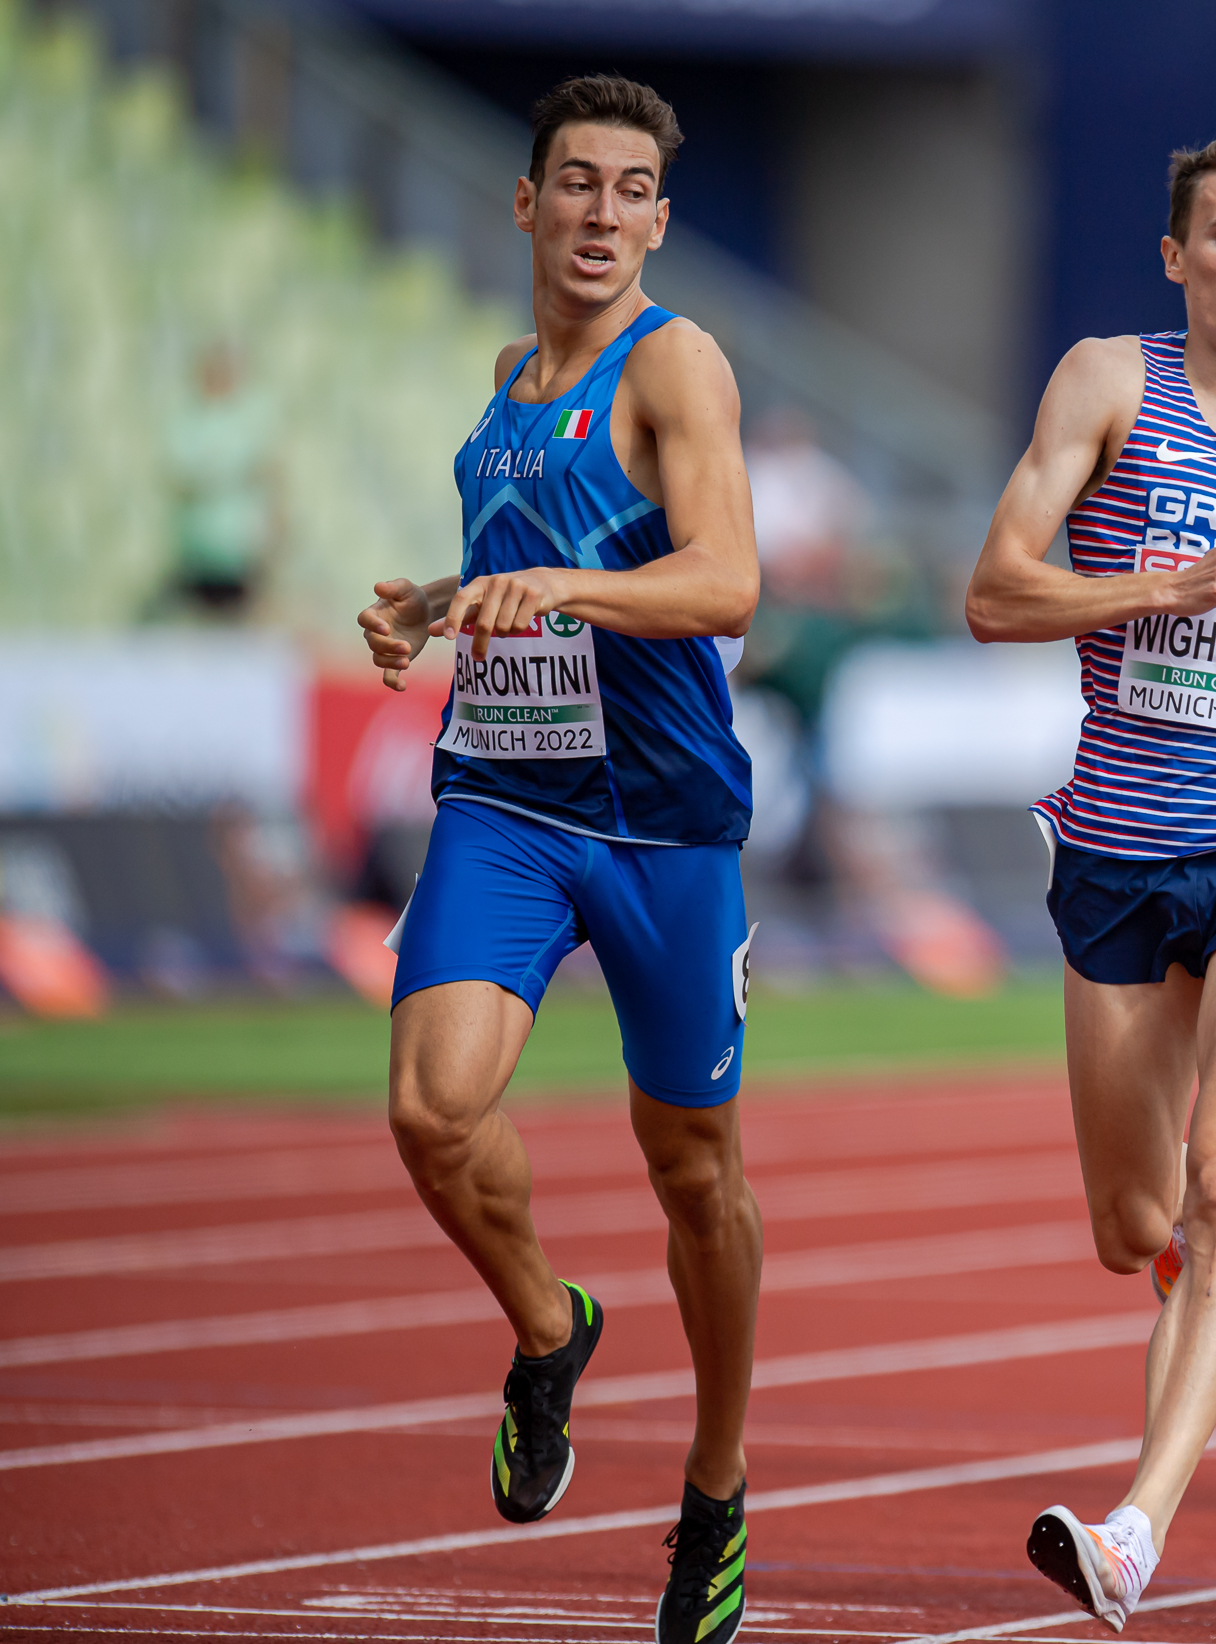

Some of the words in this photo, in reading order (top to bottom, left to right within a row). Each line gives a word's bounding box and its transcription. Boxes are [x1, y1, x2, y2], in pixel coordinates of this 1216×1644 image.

[476, 448, 545, 479] ITALIA
[456, 651, 592, 697] BARONTINI
[1161, 668, 1167, 681] I
[1170, 669, 1207, 688] RUN
[477, 708, 504, 722] RUN
[453, 726, 527, 751] MUNICH
[534, 728, 593, 751] 2022
